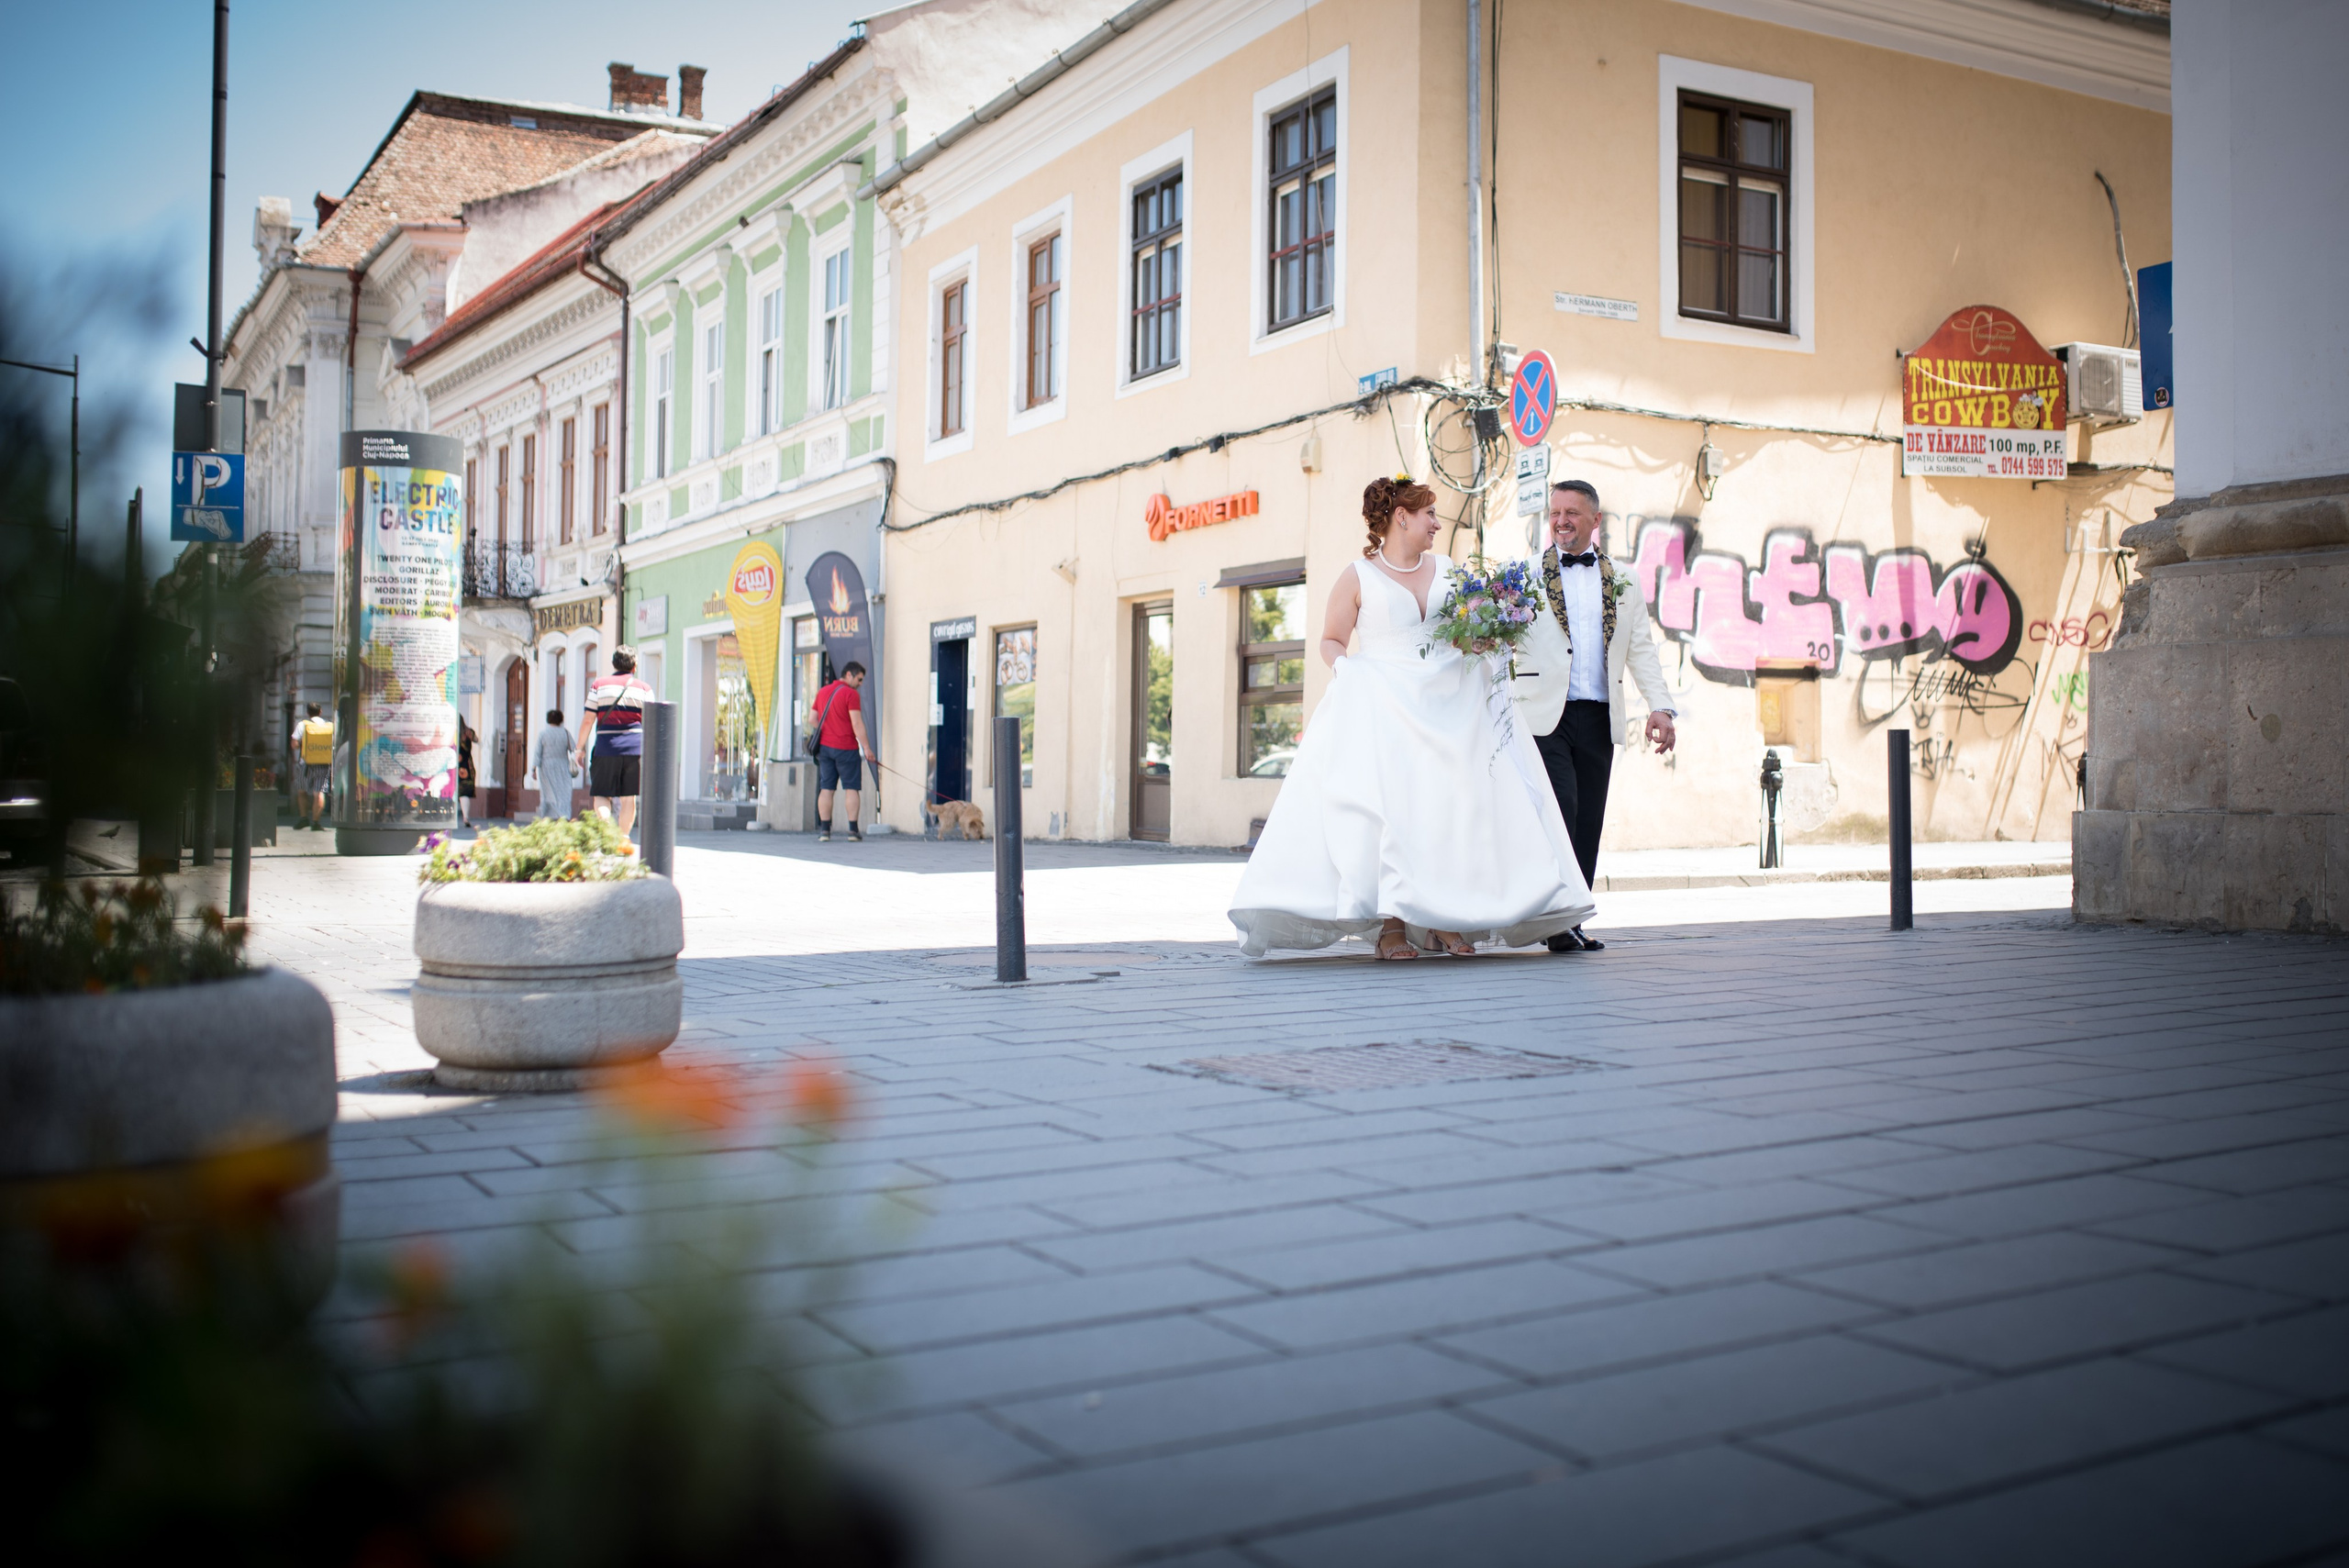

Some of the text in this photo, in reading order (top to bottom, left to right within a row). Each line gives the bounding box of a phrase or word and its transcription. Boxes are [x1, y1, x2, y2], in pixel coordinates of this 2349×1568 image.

[1569, 297, 1606, 308] HERMANN
[1608, 302, 1637, 312] OBERTH
[1909, 357, 2059, 402] TRANSYLVANIA
[1907, 432, 1922, 451] DE
[1928, 428, 1986, 454] VÂNZARE
[1988, 439, 2012, 452] 100
[362, 451, 410, 460] Cluj-Napoca
[1936, 455, 1983, 464] COMERCIAL
[1936, 465, 1967, 473] SUBSOL
[2001, 456, 2024, 474] 0744
[2028, 458, 2044, 475] 599
[2048, 459, 2064, 476] 575
[192, 454, 231, 506] P
[371, 480, 459, 510] ELECTRIC
[1164, 491, 1259, 534] FORNETTI
[380, 507, 454, 535] CASTLE
[377, 553, 412, 562] TWENTY
[399, 566, 440, 575] GORILLAZ
[363, 575, 418, 584] DISCLOSURE
[425, 578, 447, 586] PEGGY
[374, 586, 417, 595] MODERAT
[380, 597, 417, 606] EDITORS
[370, 606, 392, 616] SVEN
[540, 602, 594, 629] DEMETRA
[1806, 640, 1831, 662] 20
